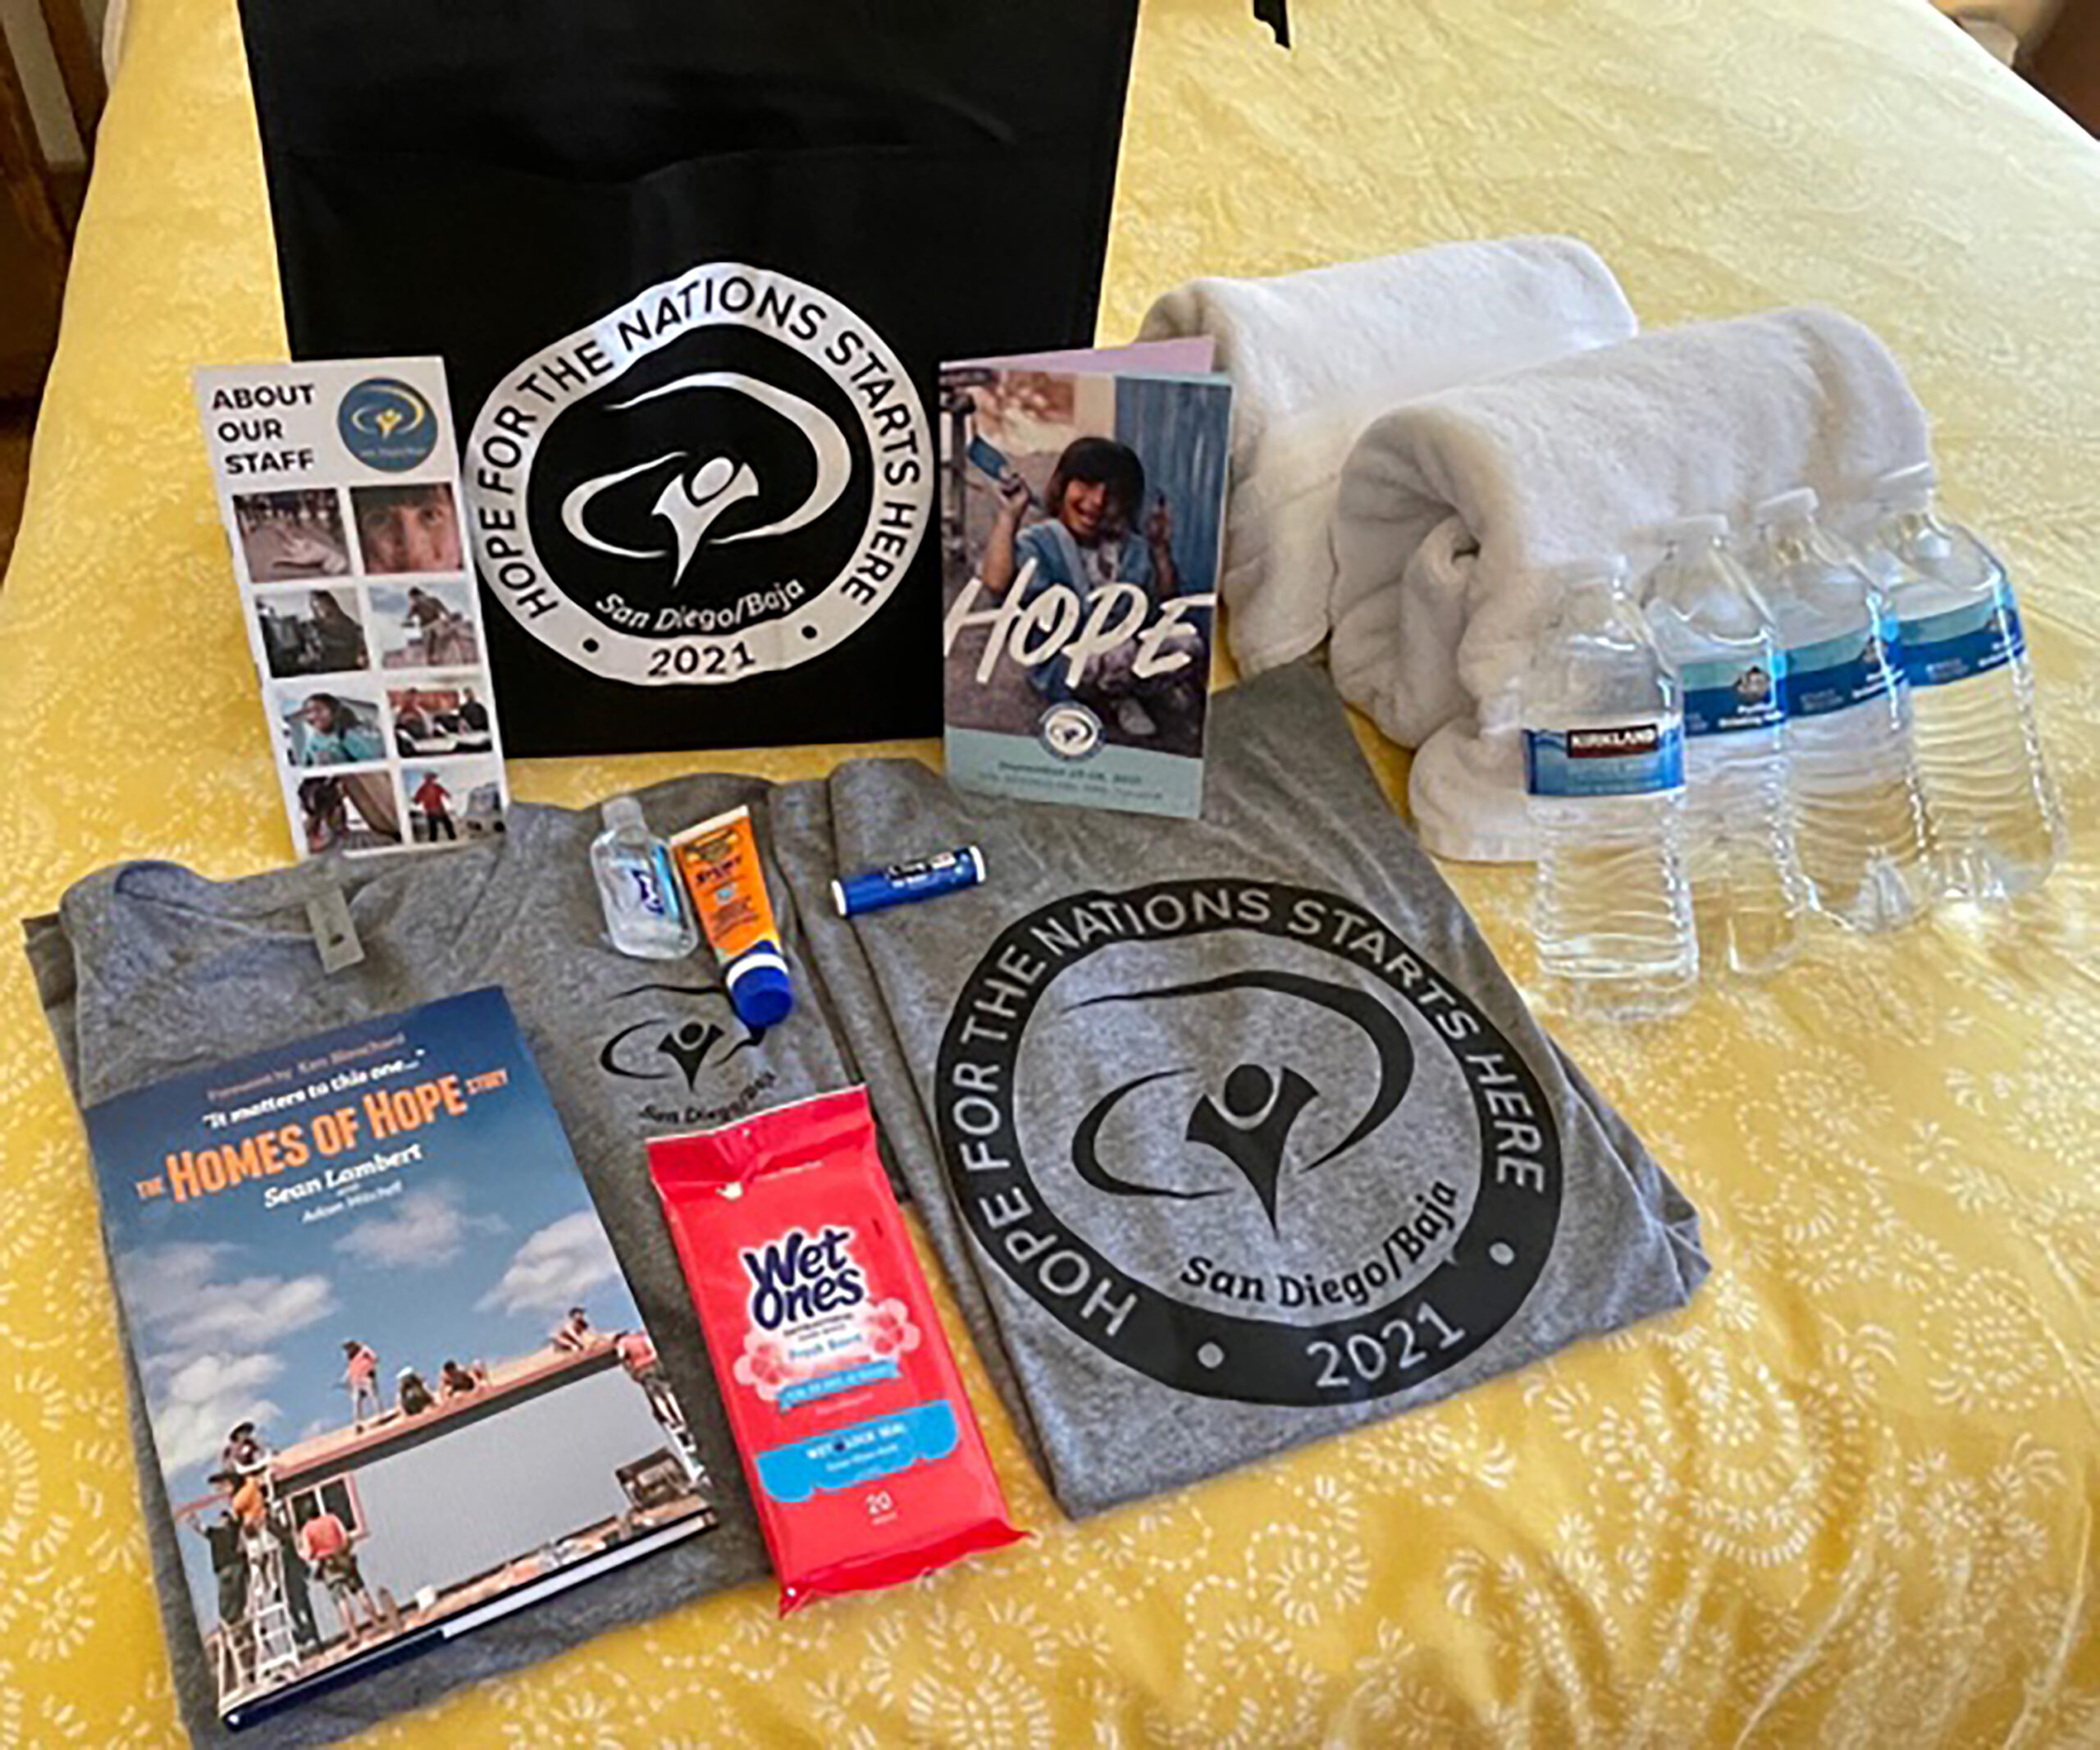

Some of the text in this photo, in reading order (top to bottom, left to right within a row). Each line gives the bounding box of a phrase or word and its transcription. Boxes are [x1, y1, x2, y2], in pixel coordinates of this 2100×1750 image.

[212, 384, 314, 410] ABOUT
[218, 418, 283, 442] OUR
[226, 449, 314, 474] STAFF
[477, 276, 921, 619] HOPE FOR THE NATIONS STARTS HERE
[596, 578, 806, 632] San Diego/Baja
[944, 557, 1217, 688] HOPE
[647, 642, 756, 677] 2021
[1572, 729, 1655, 747] KIRKLAND
[231, 1090, 306, 1122] matters
[308, 1081, 329, 1099] to
[330, 1069, 368, 1091] this
[953, 889, 1545, 1338] HOPE FOR THE NATIONS STARTS HERE
[166, 1123, 310, 1203] HOMES
[312, 1106, 360, 1156] OF
[363, 1073, 469, 1140] HOPE
[264, 1178, 322, 1209] Sean
[325, 1143, 423, 1189] Lambert
[742, 1227, 850, 1290] Wet
[1180, 1181, 1458, 1307] San Diego/Baja
[752, 1268, 865, 1331] Ones
[1306, 1303, 1467, 1389] 2021
[865, 1490, 893, 1516] 20
